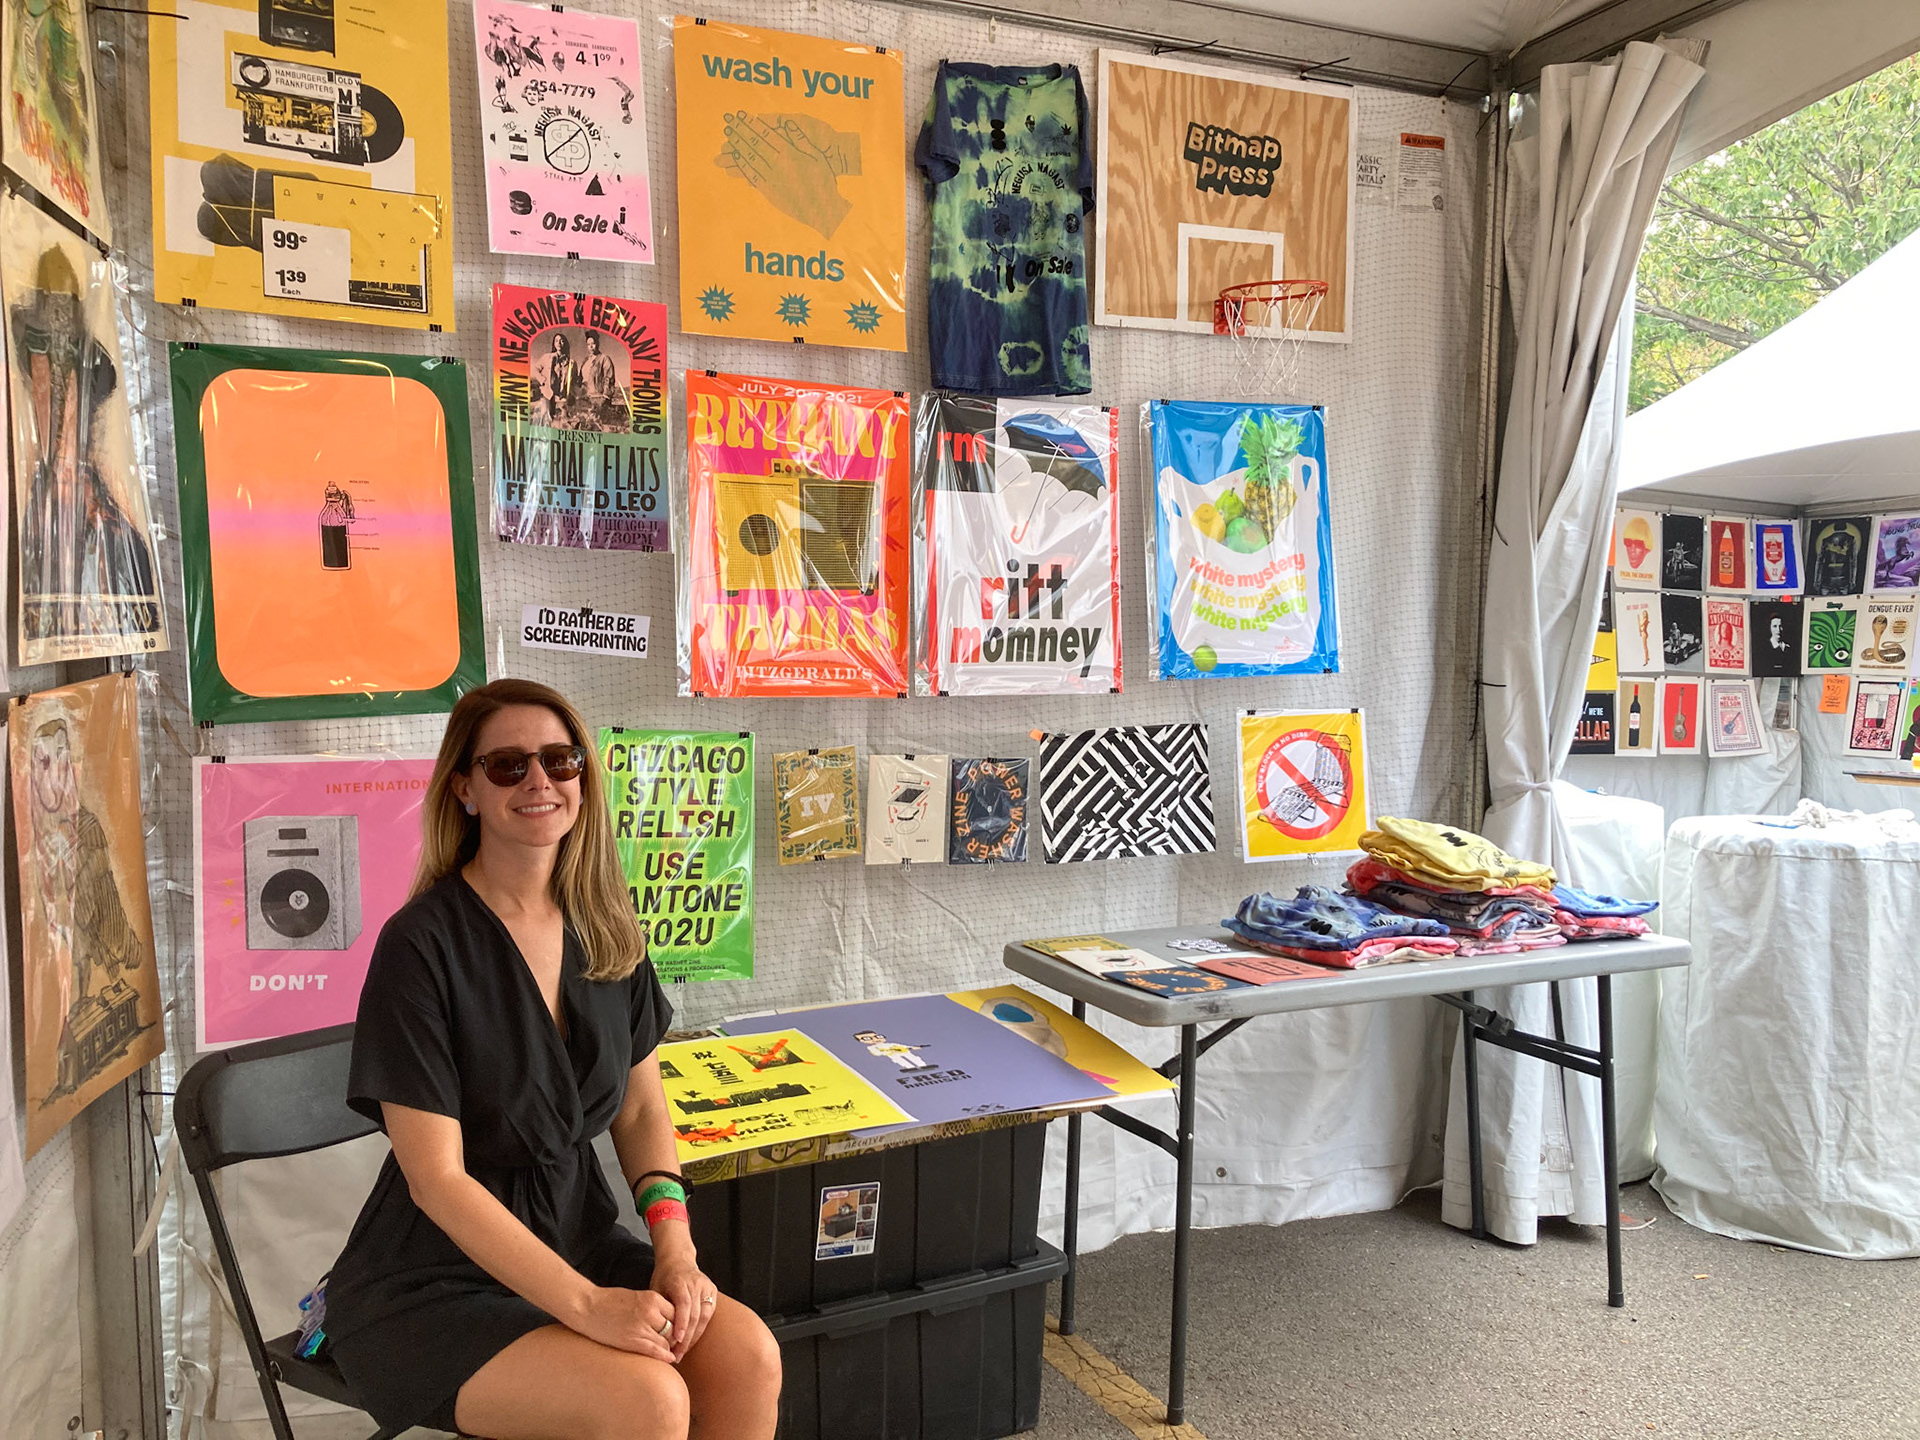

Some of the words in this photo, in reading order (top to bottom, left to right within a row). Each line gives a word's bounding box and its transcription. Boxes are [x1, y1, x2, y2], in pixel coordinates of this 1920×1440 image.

[575, 50, 587, 65] 4
[275, 69, 327, 84] HAMBURGERS
[337, 76, 352, 85] OLD
[275, 78, 334, 94] FRANKFURTERS
[701, 54, 792, 88] wash
[802, 68, 874, 99] your
[568, 105, 602, 141] NAGAST
[1188, 125, 1279, 163] Bitmap
[1200, 155, 1269, 186] Press
[1358, 154, 1383, 166] ASSIC
[1011, 163, 1034, 195] NEGUSA
[1037, 161, 1065, 190] NAGAST
[1357, 174, 1384, 185] NTALS
[542, 211, 567, 232] On
[571, 213, 609, 234] Sale
[745, 242, 845, 282] hands
[1025, 259, 1044, 277] On
[1048, 256, 1073, 275] Sale
[281, 287, 301, 296] Each
[573, 299, 585, 325] &
[500, 295, 570, 365] NEWSOME
[590, 298, 661, 364] BETHANY
[500, 369, 529, 422] TAWNY
[632, 368, 662, 435] THOMAS
[738, 382, 778, 396] JULY
[825, 391, 862, 404] 2021
[557, 429, 603, 444] PRESENT
[694, 393, 901, 459] BETHANY
[937, 431, 987, 463] rm
[603, 444, 660, 492] FLATS
[566, 487, 611, 509] TED
[615, 491, 657, 512] LEO
[1189, 556, 1235, 587] white
[1237, 553, 1306, 589] mystery
[980, 558, 1068, 620] ritt
[1190, 578, 1235, 609] white
[1238, 574, 1307, 611] mystery
[539, 607, 556, 625] I'D
[558, 610, 614, 632] RATHER
[617, 616, 636, 633] BE
[1192, 600, 1237, 630] white
[1239, 594, 1308, 632] mystery
[1868, 605, 1892, 613] DENGUE
[1894, 604, 1915, 613] FEVER
[524, 626, 647, 652] SCREENPRINTING
[703, 603, 899, 651] THOMAS
[950, 626, 1102, 678] momney
[736, 665, 873, 681] FITZGERALD'S
[607, 743, 746, 774] CHICAGO
[1260, 751, 1274, 775] BLOCK
[1280, 735, 1290, 746] NO
[626, 777, 726, 806] STYLE
[968, 761, 1022, 800] POWER
[800, 793, 834, 818] IV
[954, 791, 971, 837] ZINE
[987, 805, 993, 813] 6
[616, 809, 735, 839] RELISH
[967, 806, 1024, 860] WASHER
[645, 852, 705, 881] USE
[629, 884, 743, 914] ANTONE
[250, 974, 328, 991] DON’T
[896, 1069, 966, 1086] FRED
[844, 1135, 886, 1149] ARCHIVE
